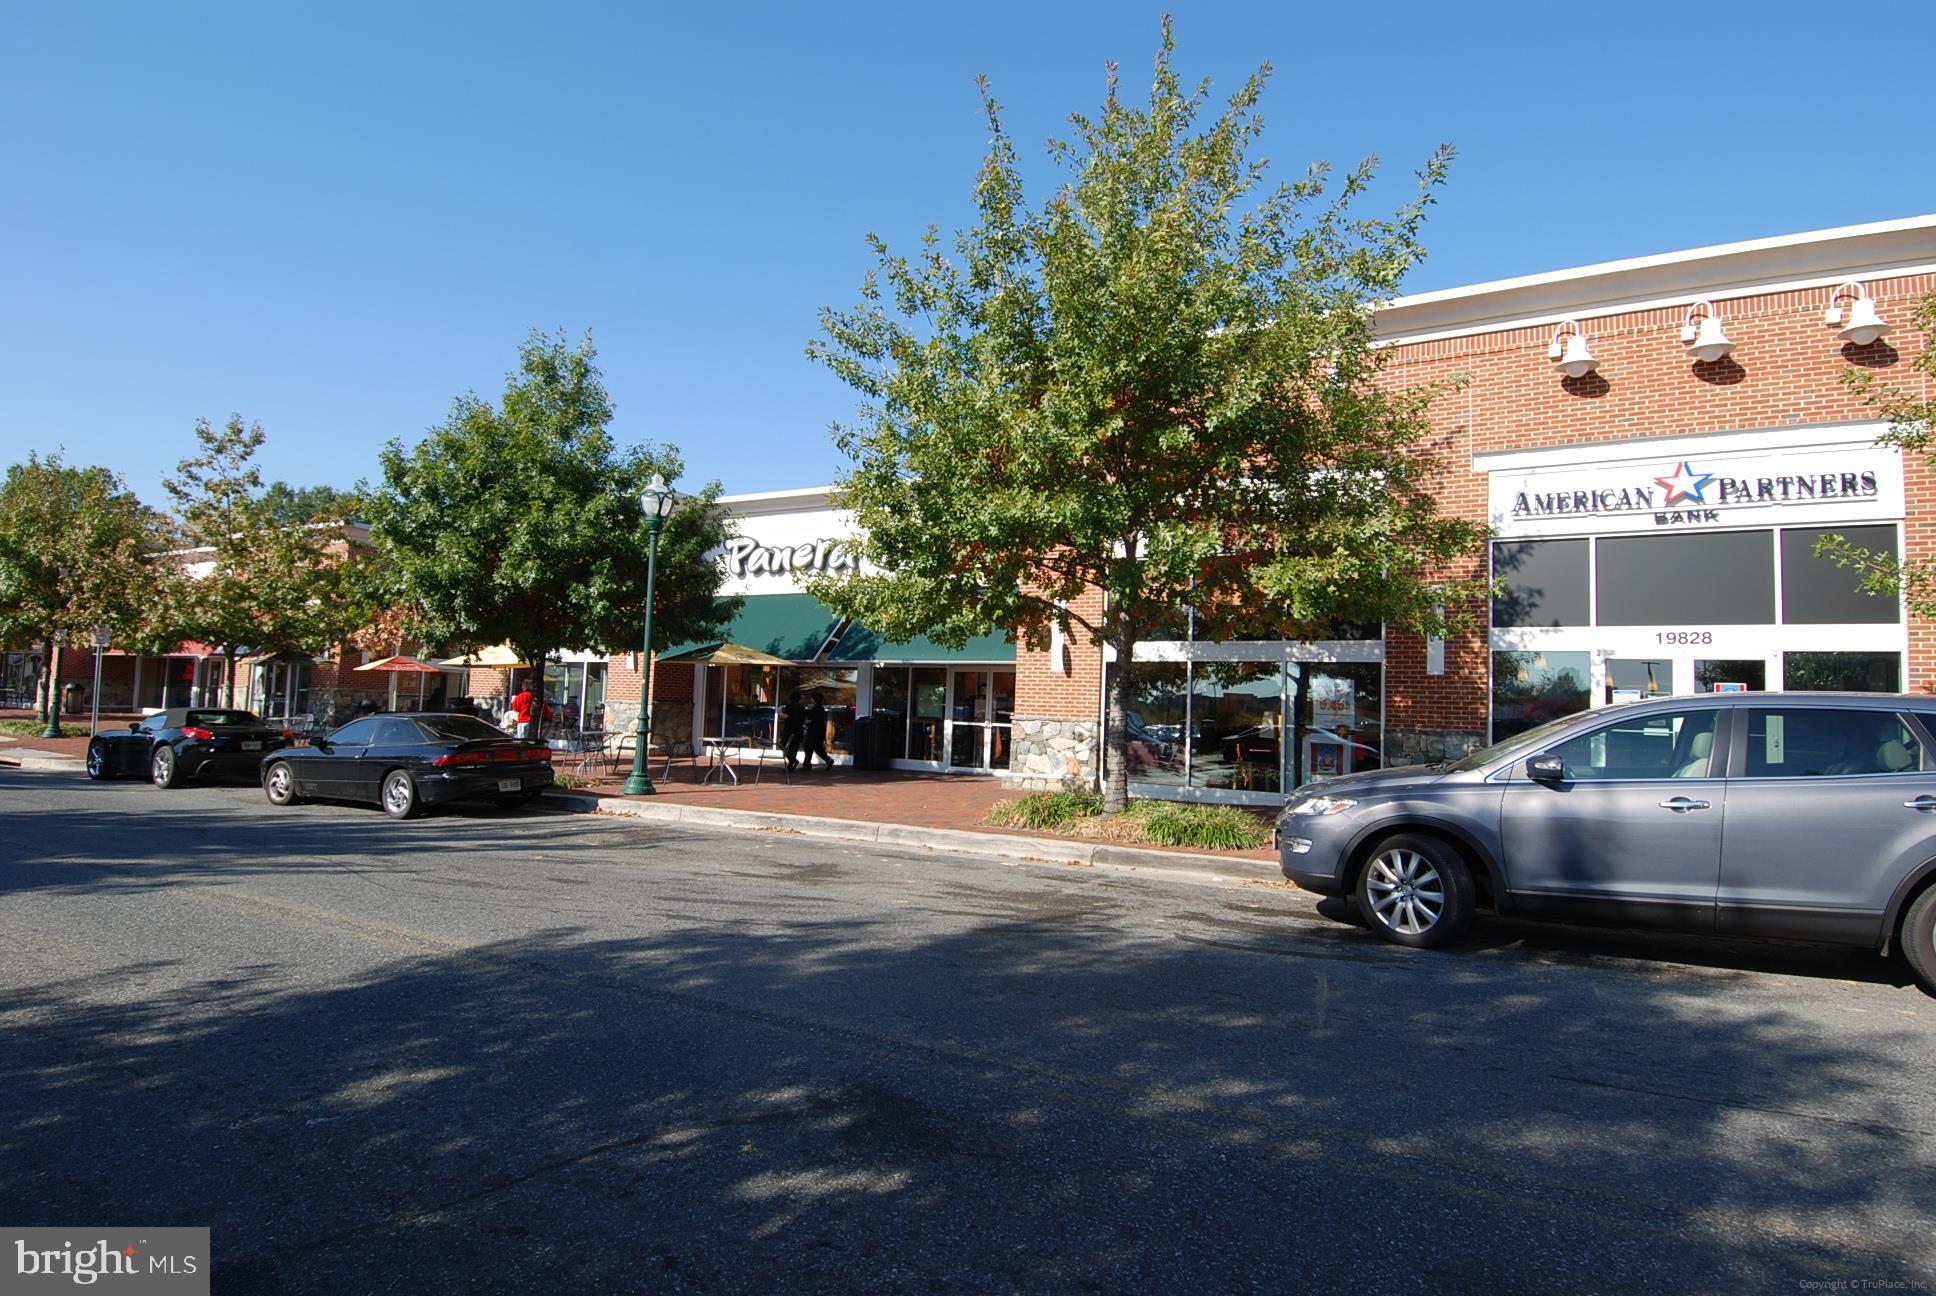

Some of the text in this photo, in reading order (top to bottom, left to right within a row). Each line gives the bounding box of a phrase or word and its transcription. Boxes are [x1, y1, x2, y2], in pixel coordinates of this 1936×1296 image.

[1511, 470, 1878, 517] AMERICAN PARTNERS
[1654, 509, 1719, 526] BANK
[723, 536, 861, 579] Panera
[1655, 631, 1713, 645] 19828
